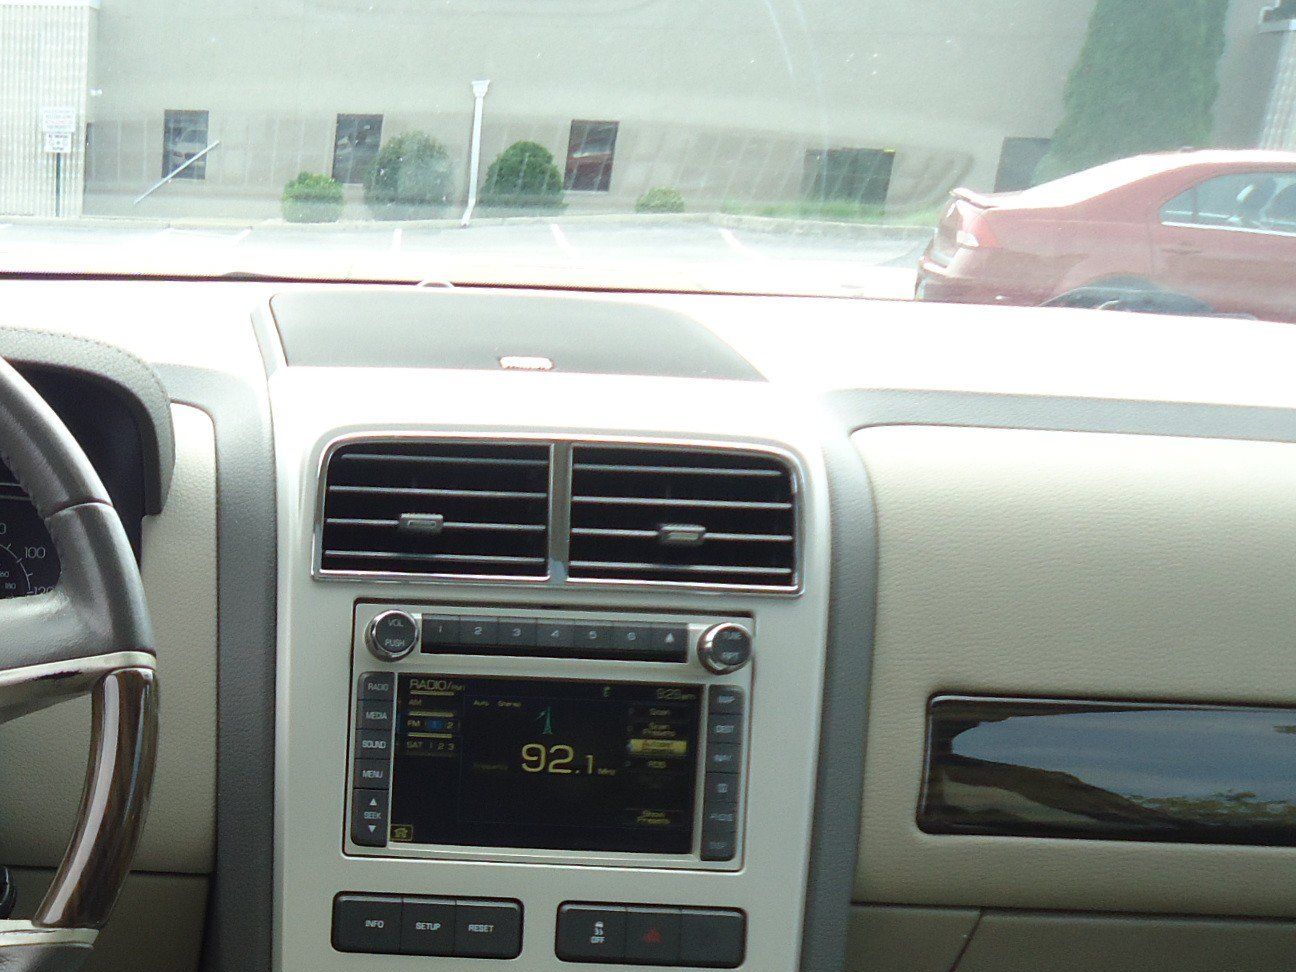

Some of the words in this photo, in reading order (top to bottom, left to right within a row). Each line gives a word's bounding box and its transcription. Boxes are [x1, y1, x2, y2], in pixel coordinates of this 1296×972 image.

[24, 546, 46, 559] 100
[388, 619, 404, 628] VOL
[473, 626, 483, 636] 2
[512, 628, 522, 637] 3
[550, 629, 560, 639] 4
[367, 682, 389, 692] RADIO
[366, 711, 388, 720] MEDIA
[362, 741, 386, 750] SOUND
[362, 769, 383, 779] MENU
[363, 811, 382, 820] SEEK
[365, 919, 384, 929] INFO
[415, 921, 442, 932] SETUP
[468, 923, 494, 933] RESET
[590, 936, 605, 944] OFF
